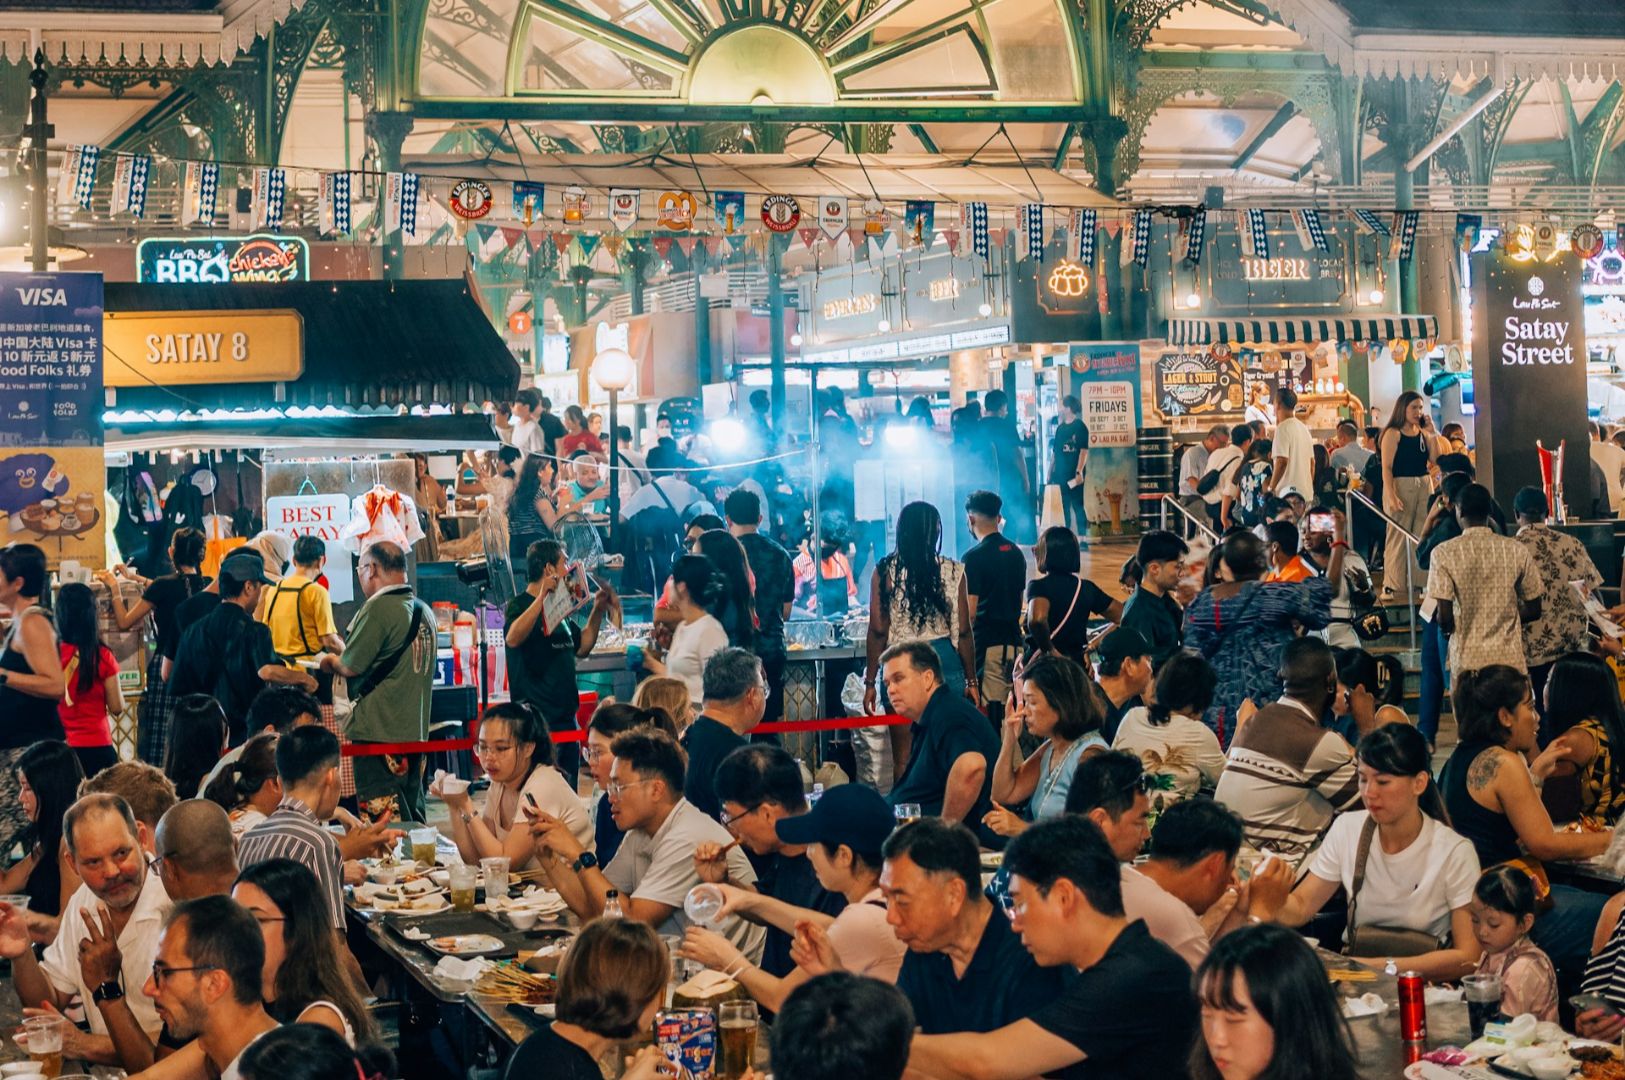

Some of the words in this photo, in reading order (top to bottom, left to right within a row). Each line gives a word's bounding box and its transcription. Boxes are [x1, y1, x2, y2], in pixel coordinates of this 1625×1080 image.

[453, 180, 491, 198] ERDINGER
[763, 196, 798, 211] ERDINGER
[1572, 225, 1602, 239] ERDINGER
[1245, 258, 1311, 280] BEER
[15, 287, 67, 306] VISA
[1505, 316, 1569, 345] Satay
[0, 336, 54, 349] 中国大陆
[55, 337, 83, 348] Visa
[85, 336, 98, 349] 卡
[145, 332, 222, 363] SATAY
[232, 331, 248, 361] 8
[4, 351, 19, 362] 10
[1501, 342, 1574, 365] Street
[0, 364, 27, 376] ood
[30, 364, 64, 376] Folks
[66, 364, 92, 377] 礼券
[1163, 372, 1187, 384] LAGER
[1194, 371, 1217, 383] STOUT
[1088, 385, 1103, 394] 7PM
[1089, 401, 1127, 412] FRIDAYS
[281, 505, 336, 523] BEST
[275, 524, 344, 540] ATAY
[119, 672, 138, 680] VER
[684, 1045, 712, 1063] Tiger
